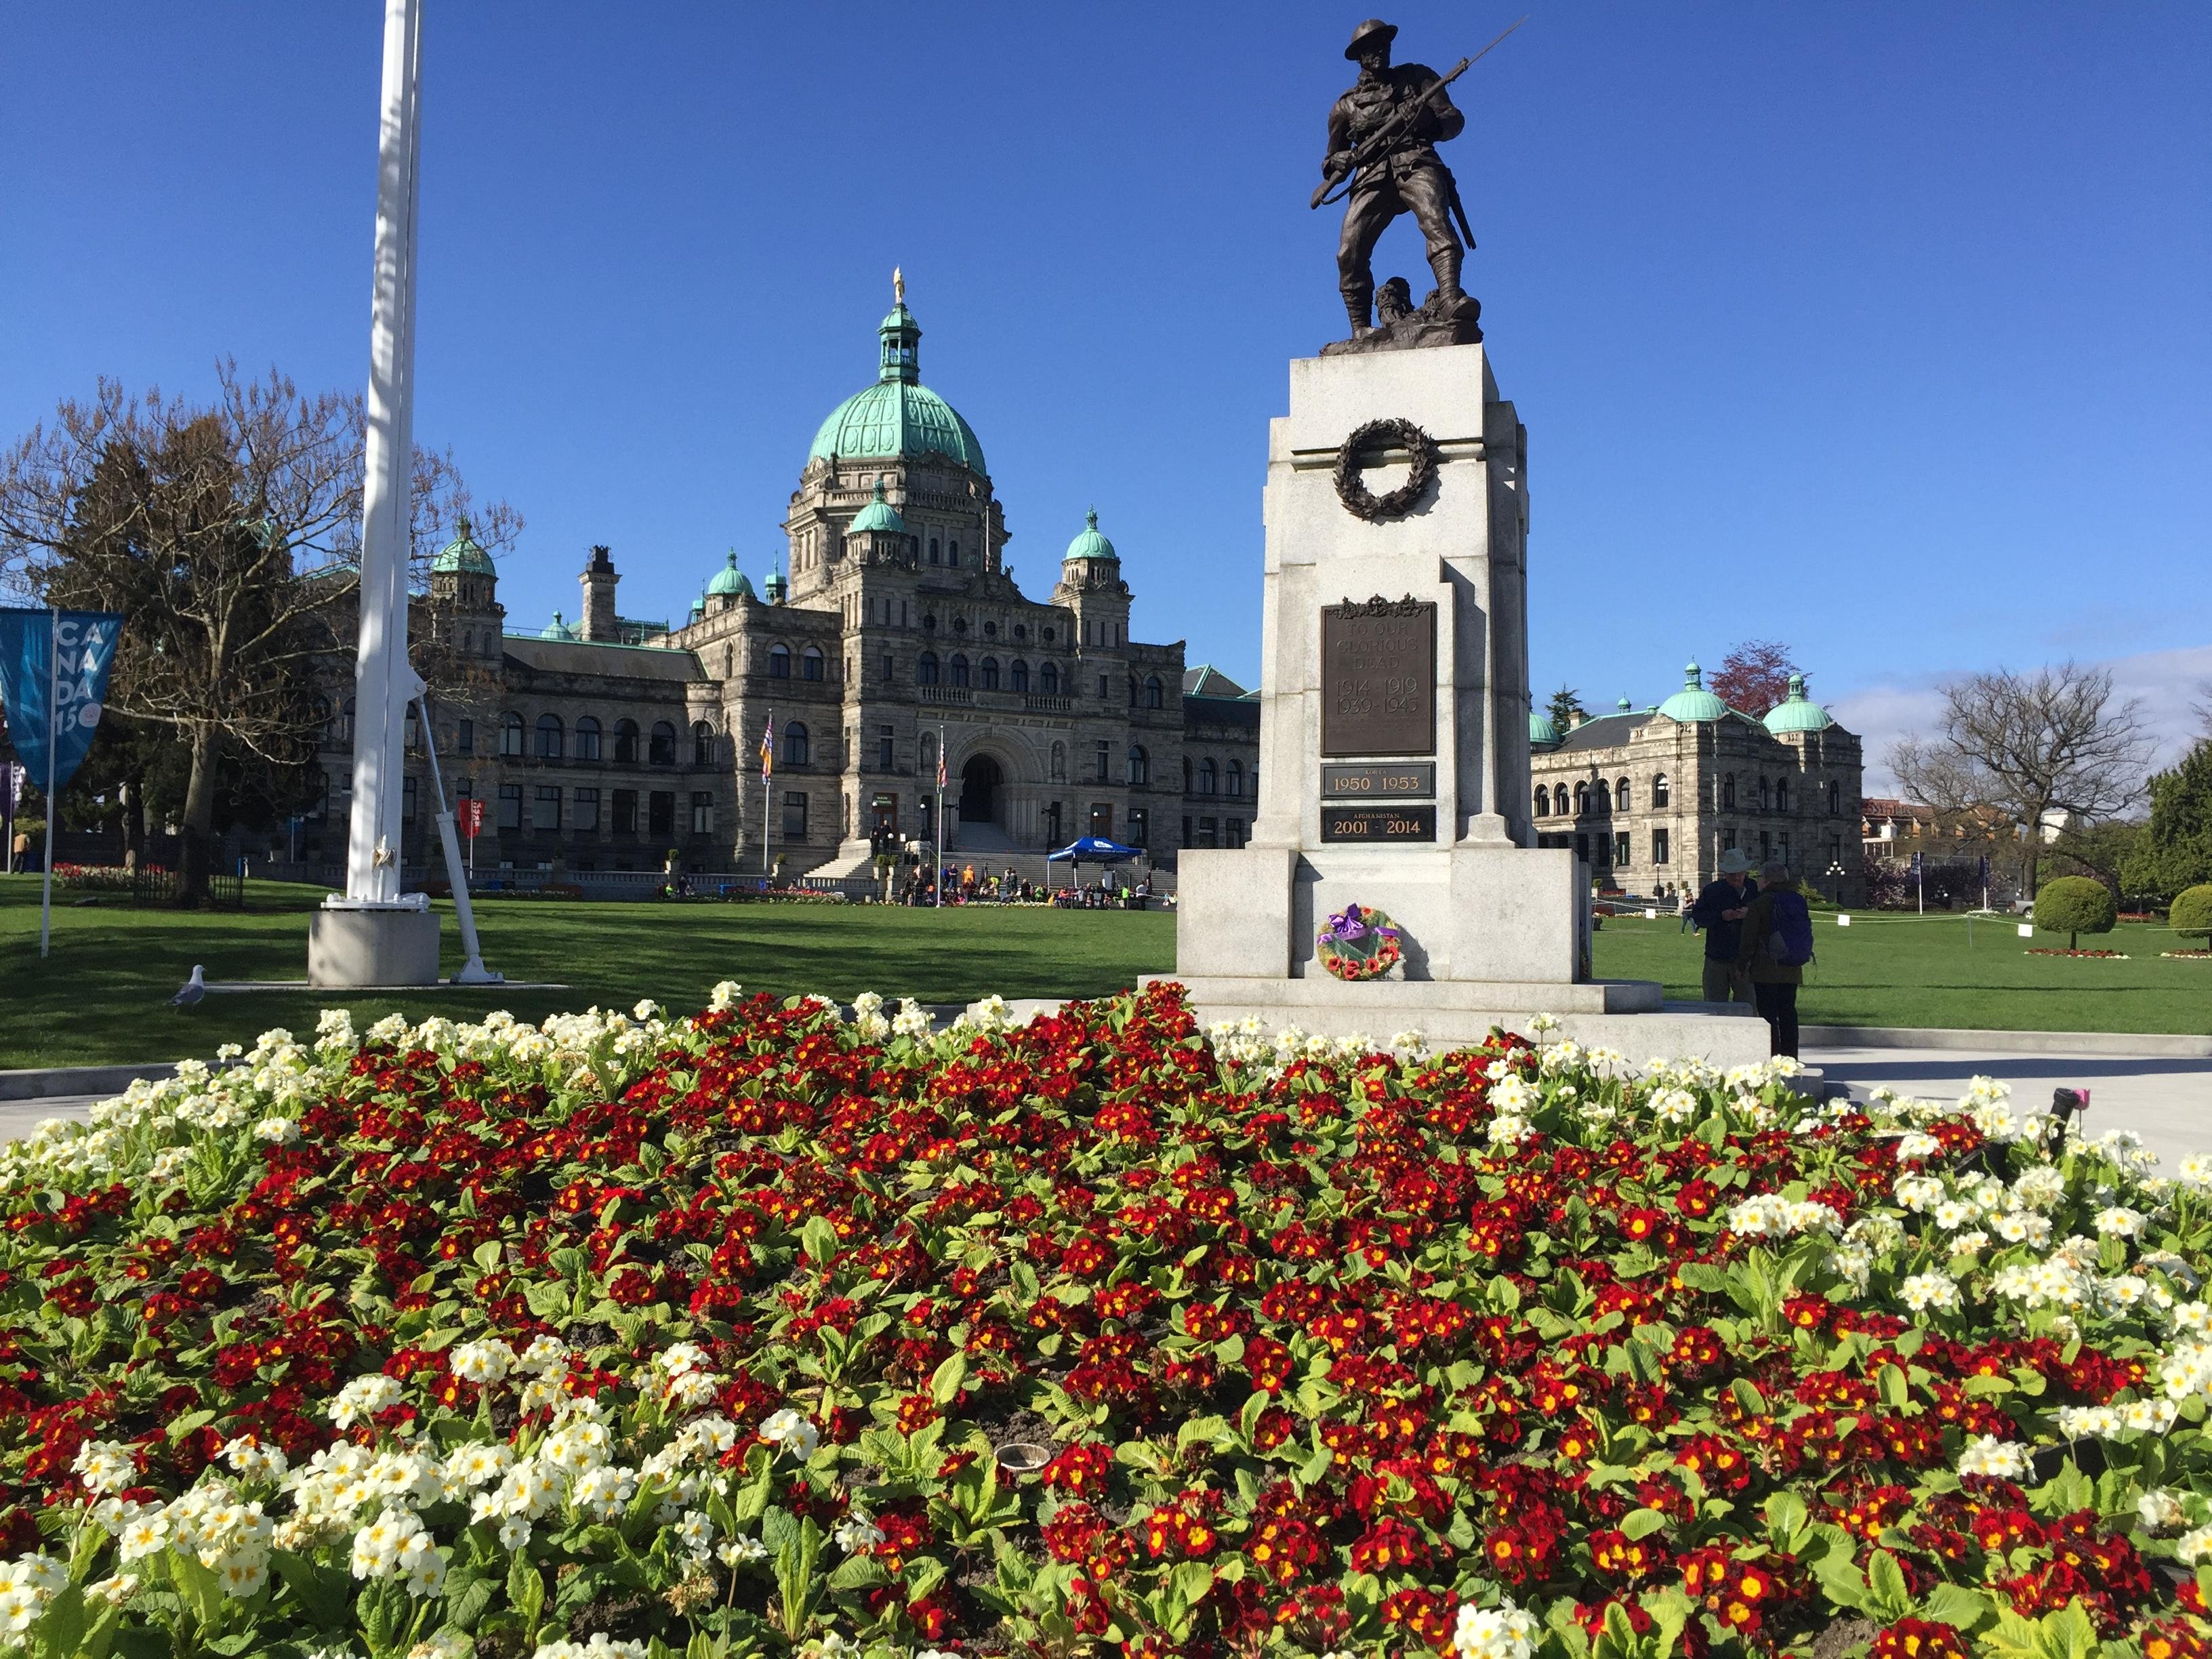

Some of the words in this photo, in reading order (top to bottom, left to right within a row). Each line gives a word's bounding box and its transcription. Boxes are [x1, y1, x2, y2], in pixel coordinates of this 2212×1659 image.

[57, 621, 103, 646] CA
[1345, 623, 1368, 636] TO
[1374, 621, 1409, 635] OUR
[1336, 638, 1419, 653] GLORIOUS
[57, 649, 98, 675] NA
[1354, 655, 1399, 670] DEAD
[56, 678, 92, 705] DA
[1336, 679, 1370, 697] 1914
[1385, 677, 1418, 695] 1919
[1337, 697, 1372, 715] 1939
[1384, 697, 1420, 714] 1945
[1334, 777, 1371, 791] 1950
[1382, 777, 1419, 790] 1953
[1334, 821, 1368, 834] 2001
[1387, 820, 1421, 834] 2014
